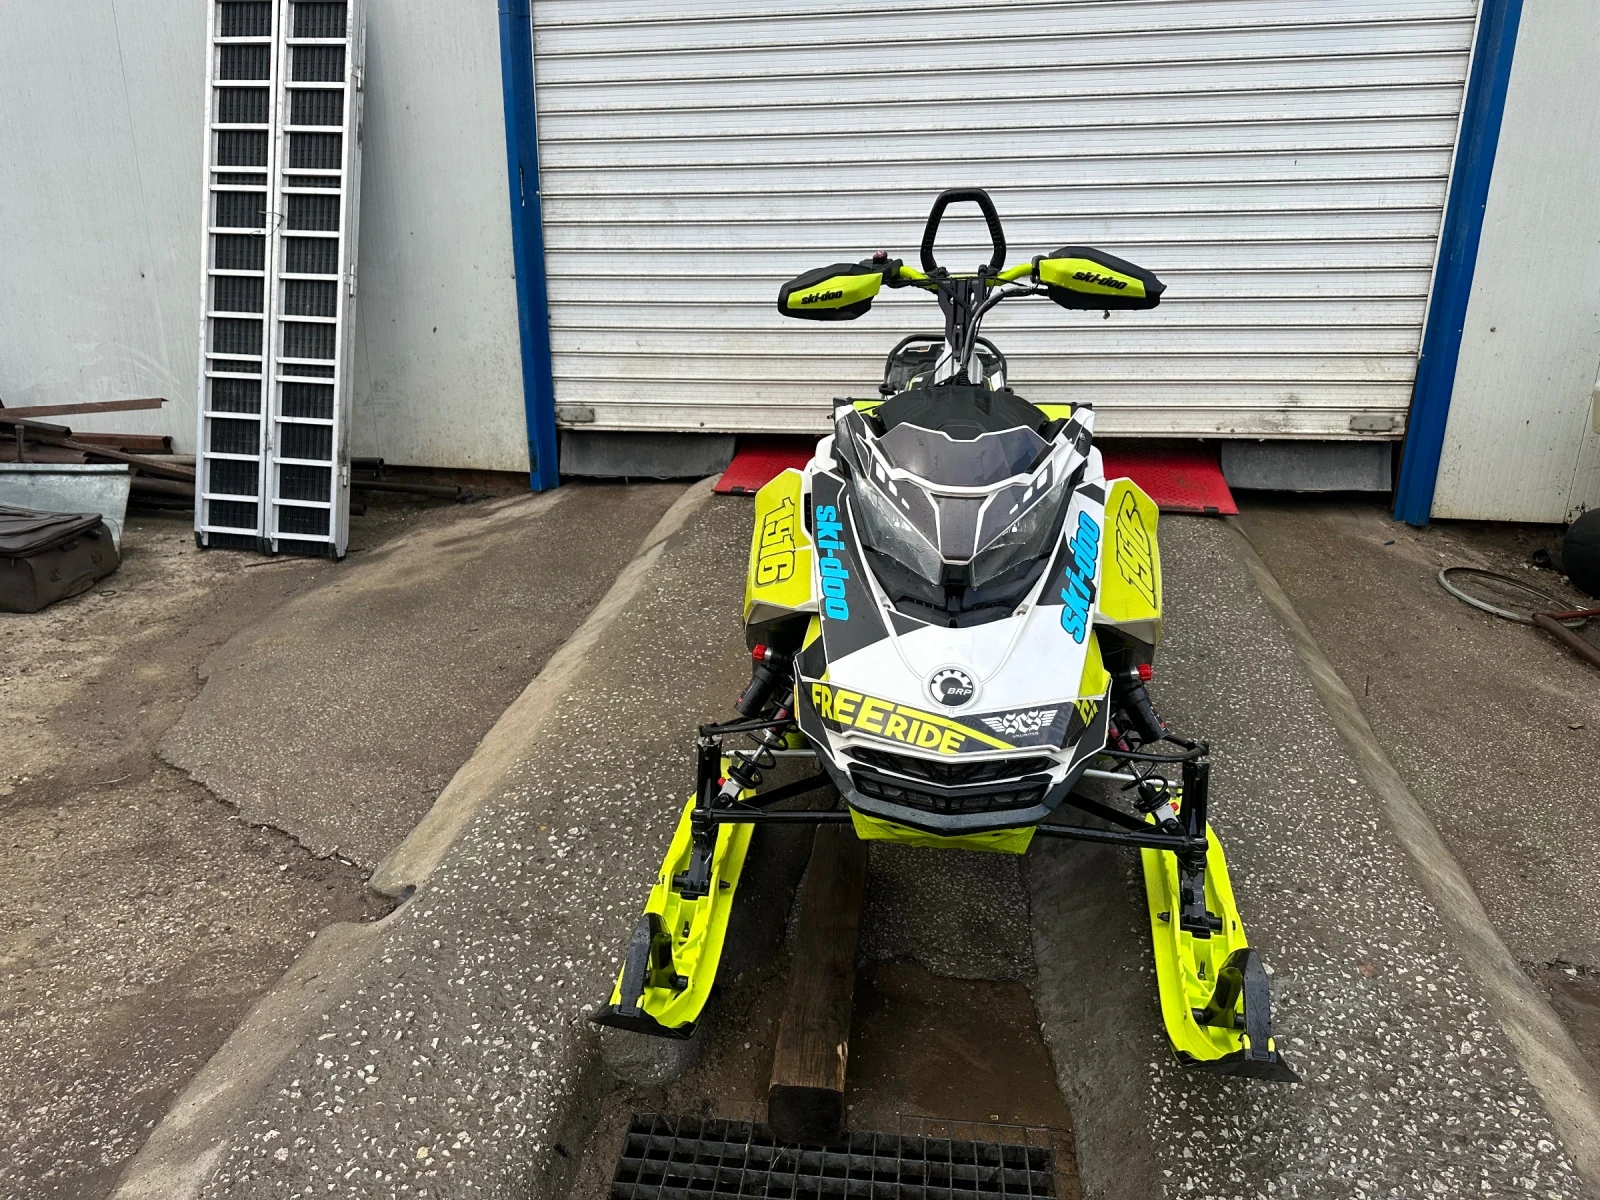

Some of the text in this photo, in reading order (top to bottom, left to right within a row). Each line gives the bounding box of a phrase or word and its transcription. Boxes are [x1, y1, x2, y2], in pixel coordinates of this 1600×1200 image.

[801, 290, 843, 305] ski-doo
[1071, 270, 1128, 290] ski-doo
[816, 505, 849, 621] ski-doo
[1061, 510, 1101, 645] ski-doo
[946, 687, 973, 696] BRP
[811, 683, 968, 754] FREERIDE
